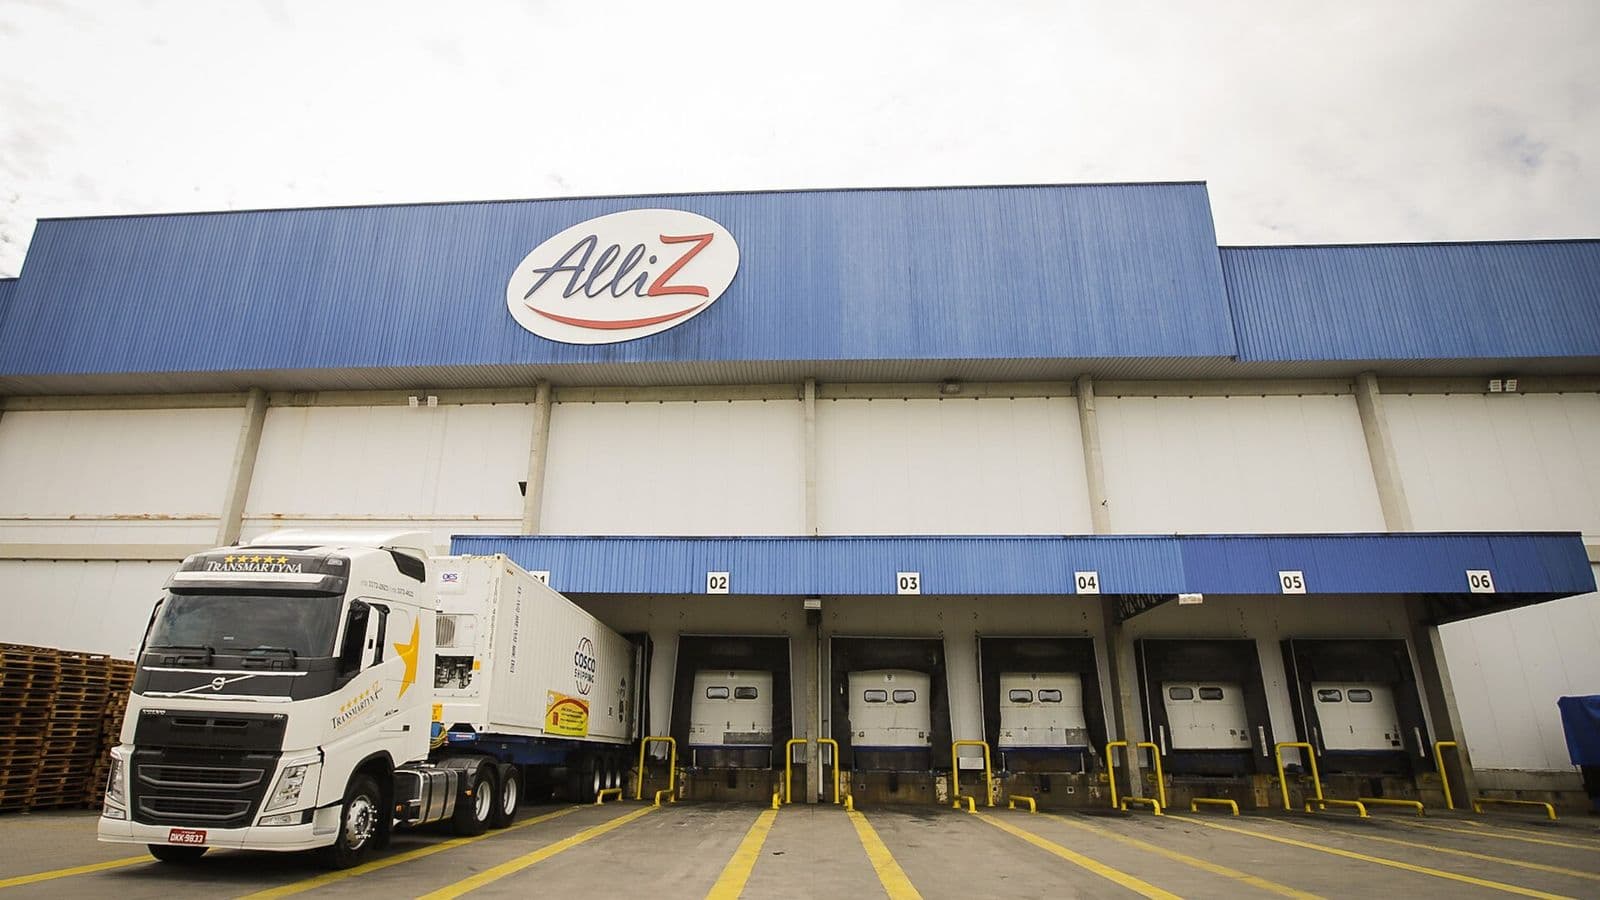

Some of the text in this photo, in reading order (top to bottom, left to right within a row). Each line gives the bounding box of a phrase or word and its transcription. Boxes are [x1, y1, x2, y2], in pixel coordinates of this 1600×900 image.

[523, 232, 714, 300] AlliZ
[710, 577, 727, 589] 02
[900, 577, 918, 590] 03
[1078, 576, 1096, 589] 04
[1283, 576, 1302, 589] 05
[1471, 575, 1490, 588] 06
[574, 651, 596, 673] COSCO
